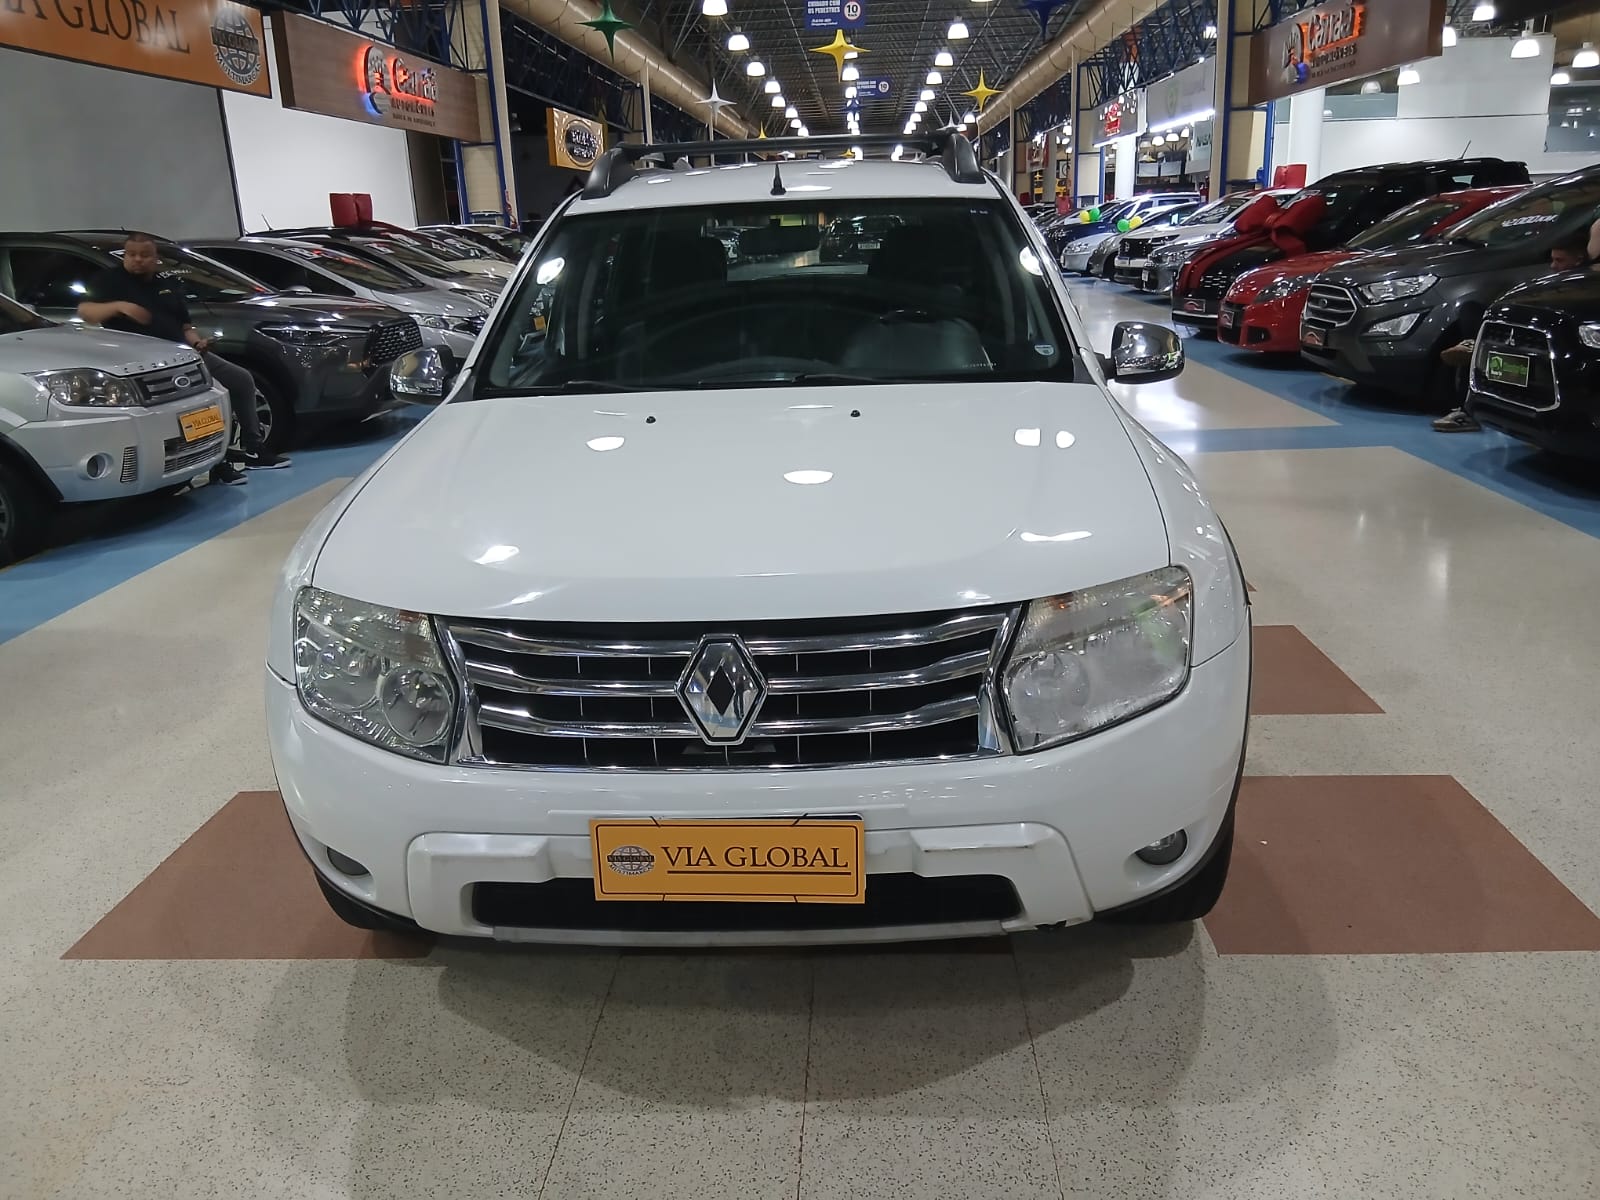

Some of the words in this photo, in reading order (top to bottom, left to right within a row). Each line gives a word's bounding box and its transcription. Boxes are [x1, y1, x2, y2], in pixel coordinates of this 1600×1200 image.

[846, 5, 858, 13] 10
[54, 0, 190, 54] GLOBAL
[661, 846, 717, 867] VIA
[724, 846, 849, 868] GLOBAL
